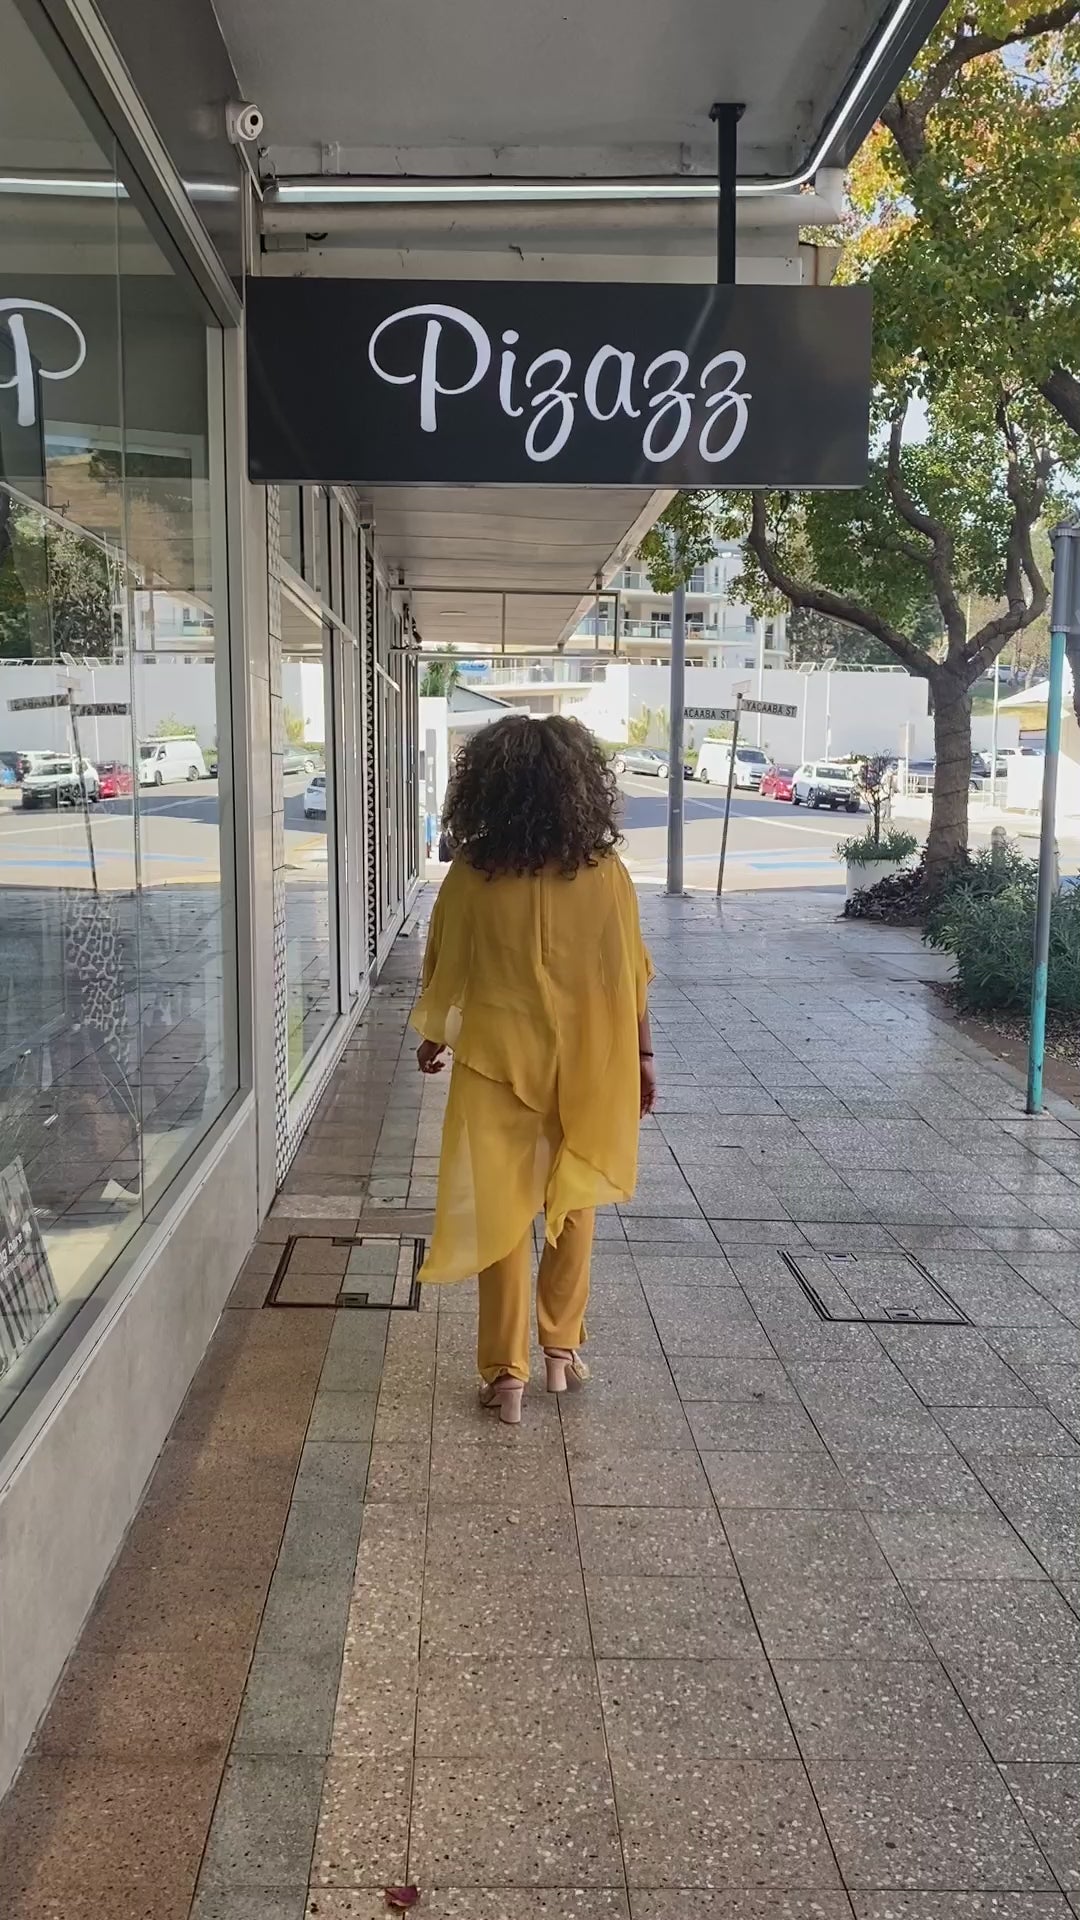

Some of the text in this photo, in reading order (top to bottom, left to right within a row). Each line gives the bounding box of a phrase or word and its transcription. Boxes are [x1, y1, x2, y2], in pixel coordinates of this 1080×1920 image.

[368, 304, 752, 462] Pizazz
[684, 709, 730, 719] ACAABA ST
[747, 701, 795, 716] YACAABA ST
